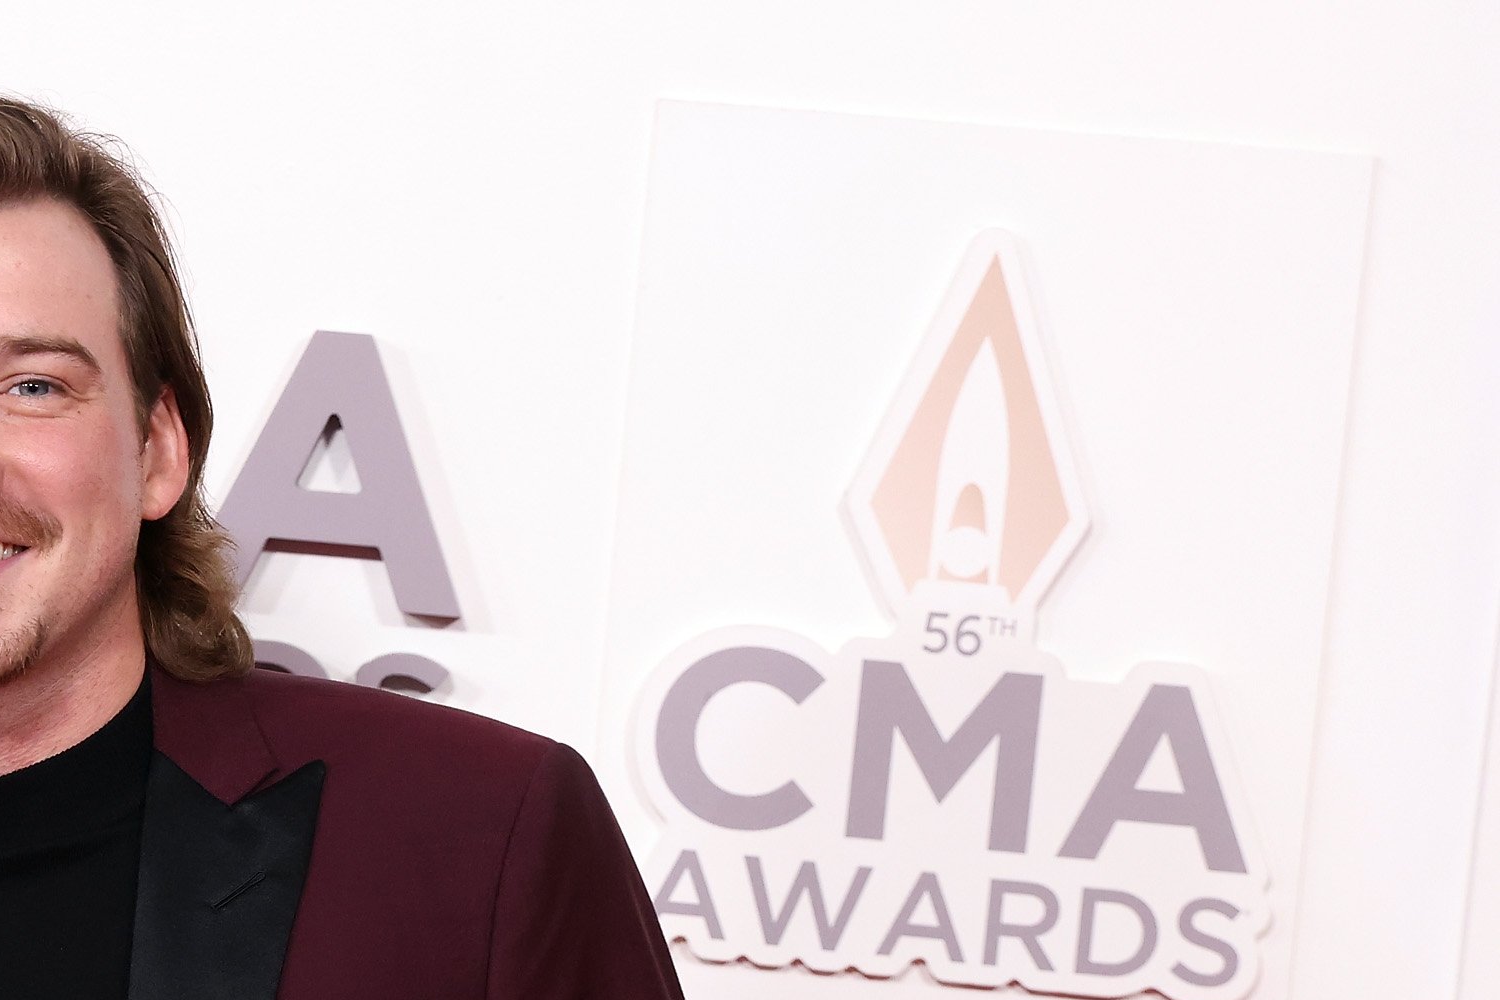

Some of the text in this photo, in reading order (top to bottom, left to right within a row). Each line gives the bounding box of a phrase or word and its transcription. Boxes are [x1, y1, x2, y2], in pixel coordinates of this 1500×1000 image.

[922, 611, 1018, 657] 56TH
[654, 646, 1249, 874] CMA
[654, 848, 1241, 988] AWARDS
